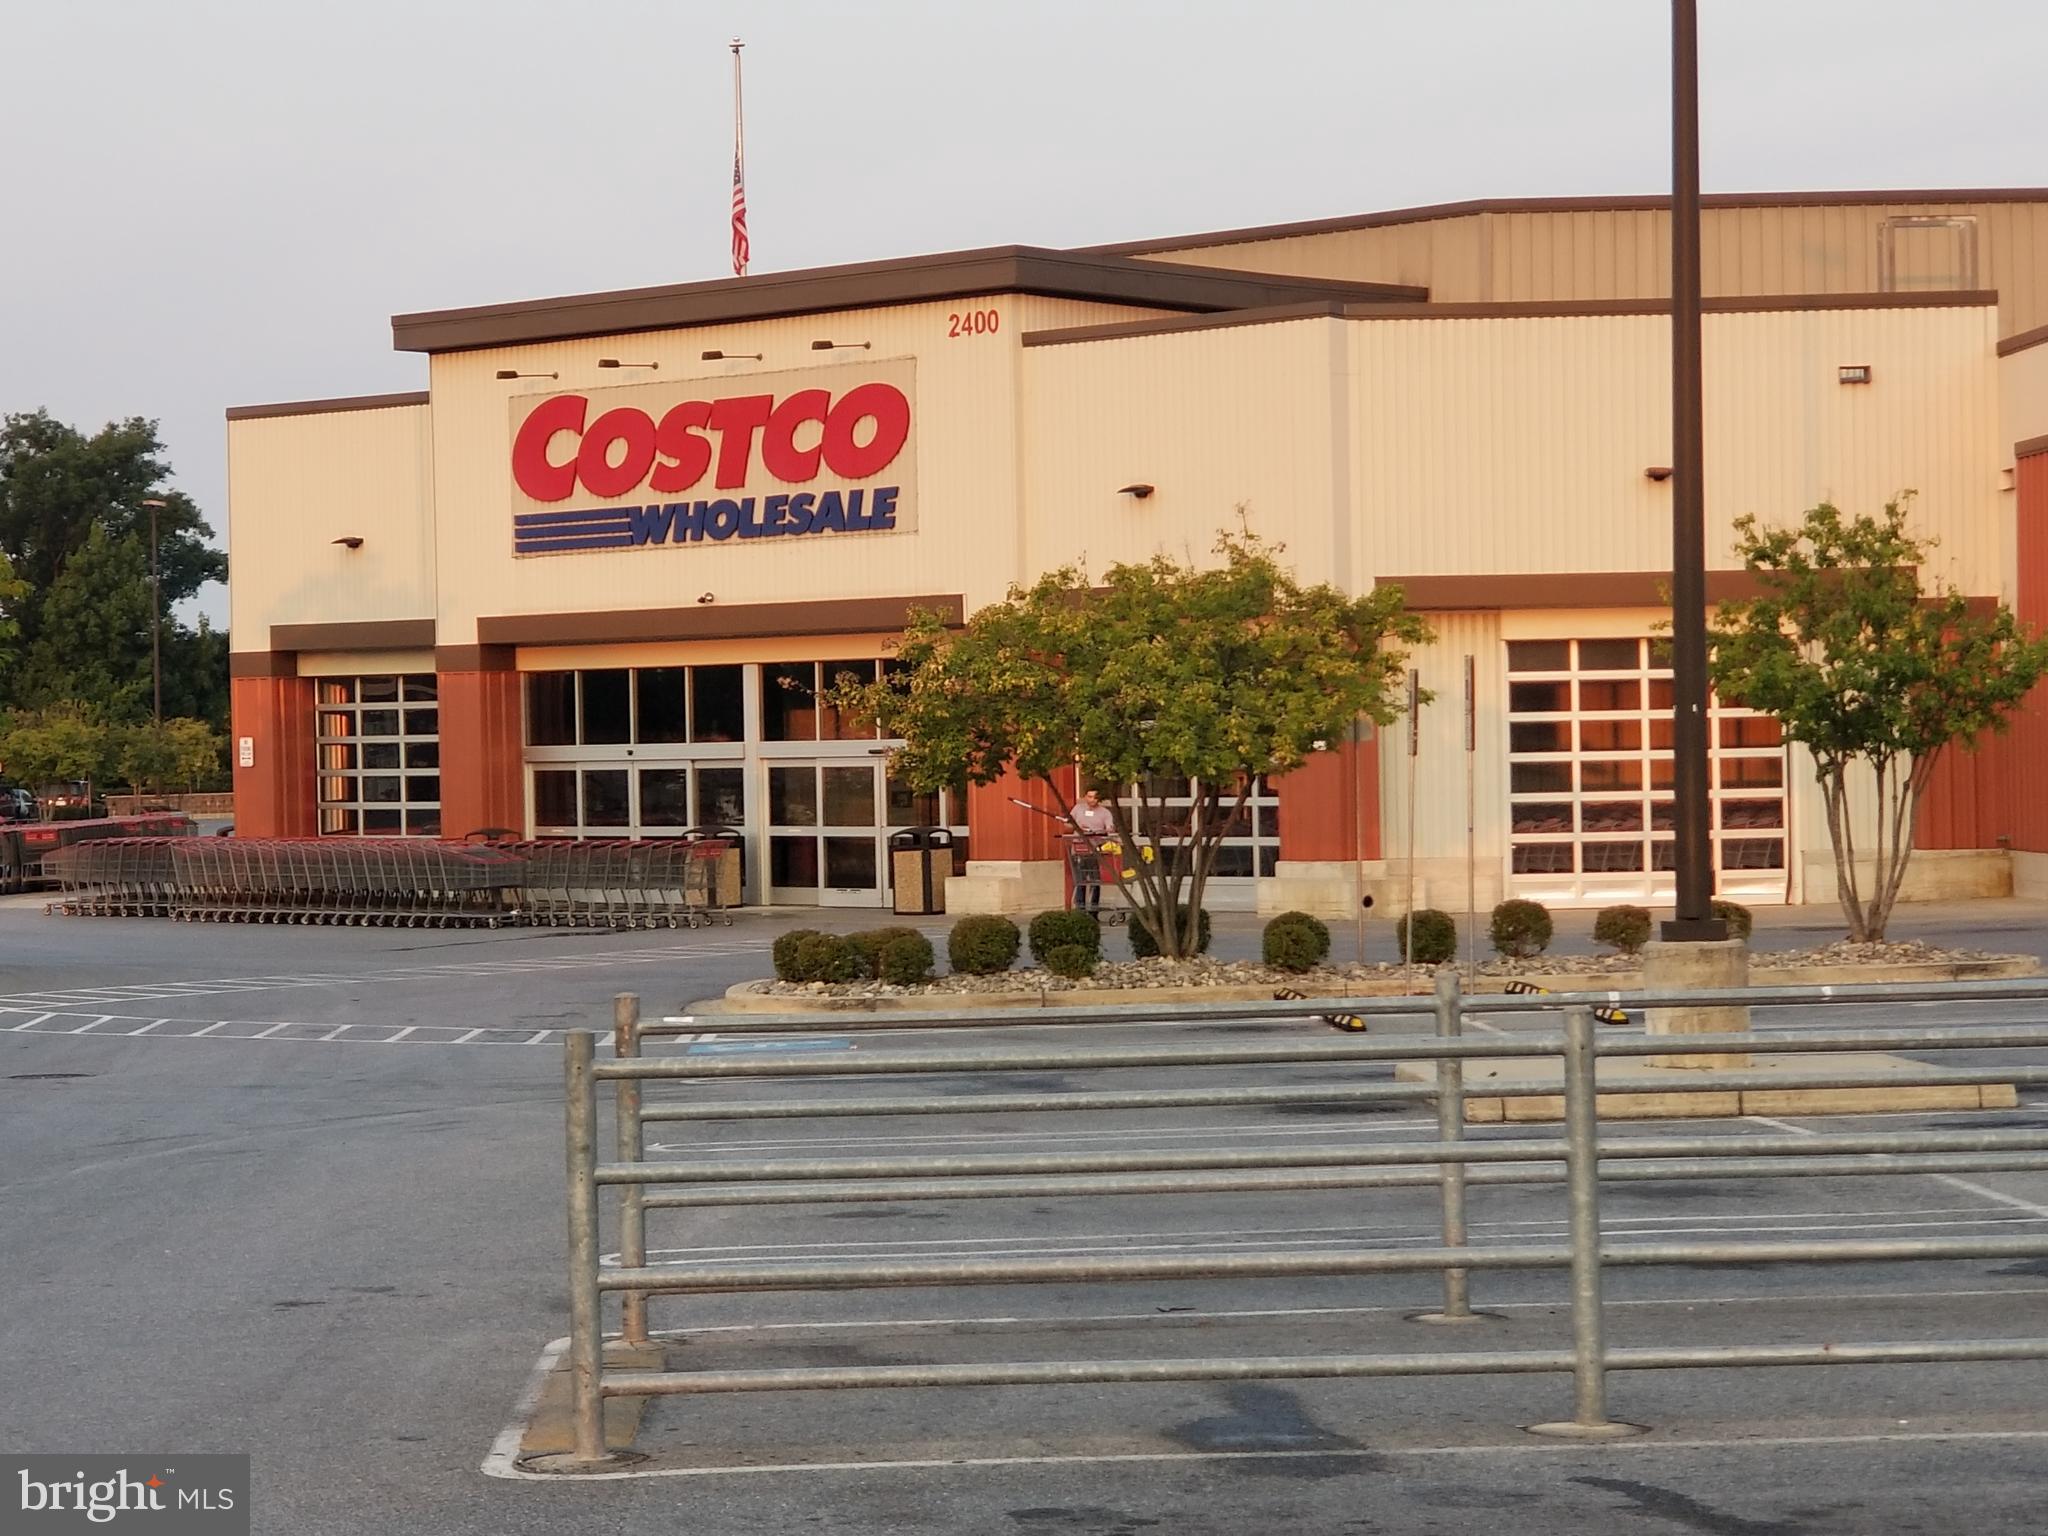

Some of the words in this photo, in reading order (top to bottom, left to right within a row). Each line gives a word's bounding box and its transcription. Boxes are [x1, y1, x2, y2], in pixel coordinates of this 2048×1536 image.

[948, 309, 1000, 338] 2400
[512, 383, 910, 502] COSTCO
[629, 486, 900, 546] WHOLESALE
